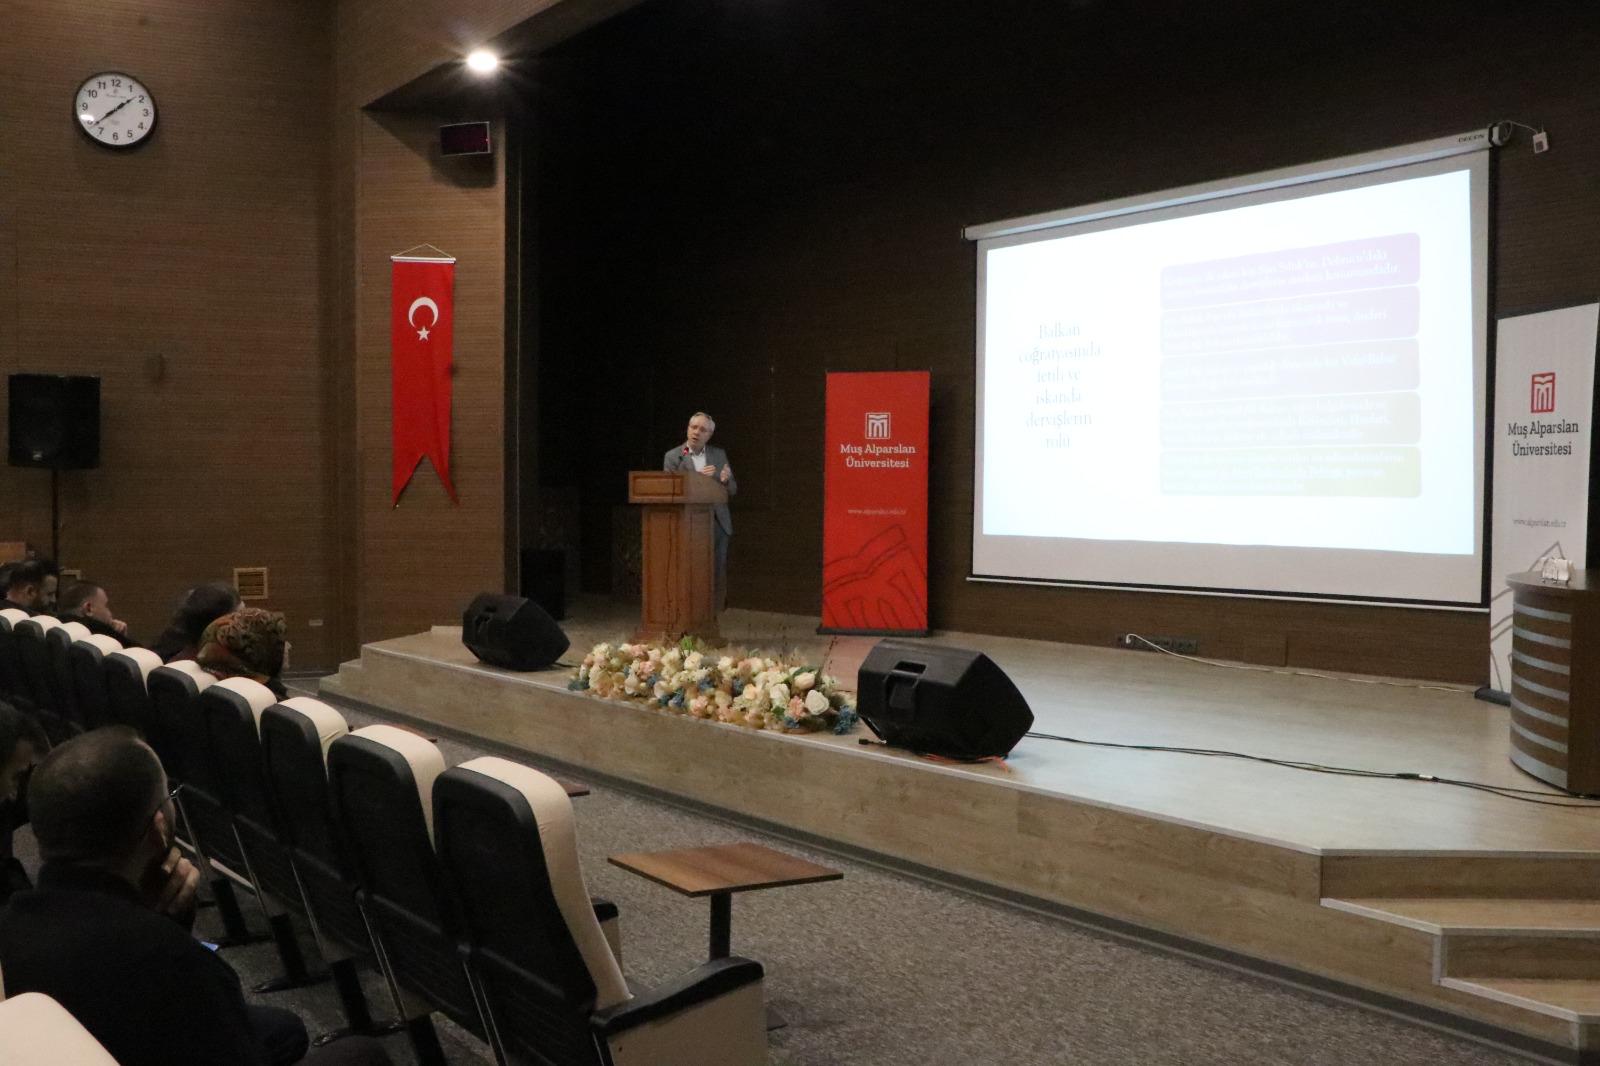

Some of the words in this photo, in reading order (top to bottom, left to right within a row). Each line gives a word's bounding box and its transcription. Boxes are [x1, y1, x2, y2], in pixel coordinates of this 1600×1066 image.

[97, 81, 106, 90] 11
[111, 79, 121, 88] 12
[87, 89, 98, 98] 10
[138, 95, 145, 104] 2
[82, 102, 89, 111] 9
[143, 108, 149, 117] 3
[137, 122, 144, 130] 4
[98, 127, 104, 135] 7
[127, 129, 133, 138] 5
[112, 132, 119, 141] 6
[1507, 422, 1528, 438] Muş
[1529, 419, 1579, 438] Alparslan
[840, 444, 863, 455] Muş
[864, 443, 916, 455] Alparslan
[1512, 440, 1572, 457] Üniversitesi
[846, 456, 909, 468] Üniversitesi
